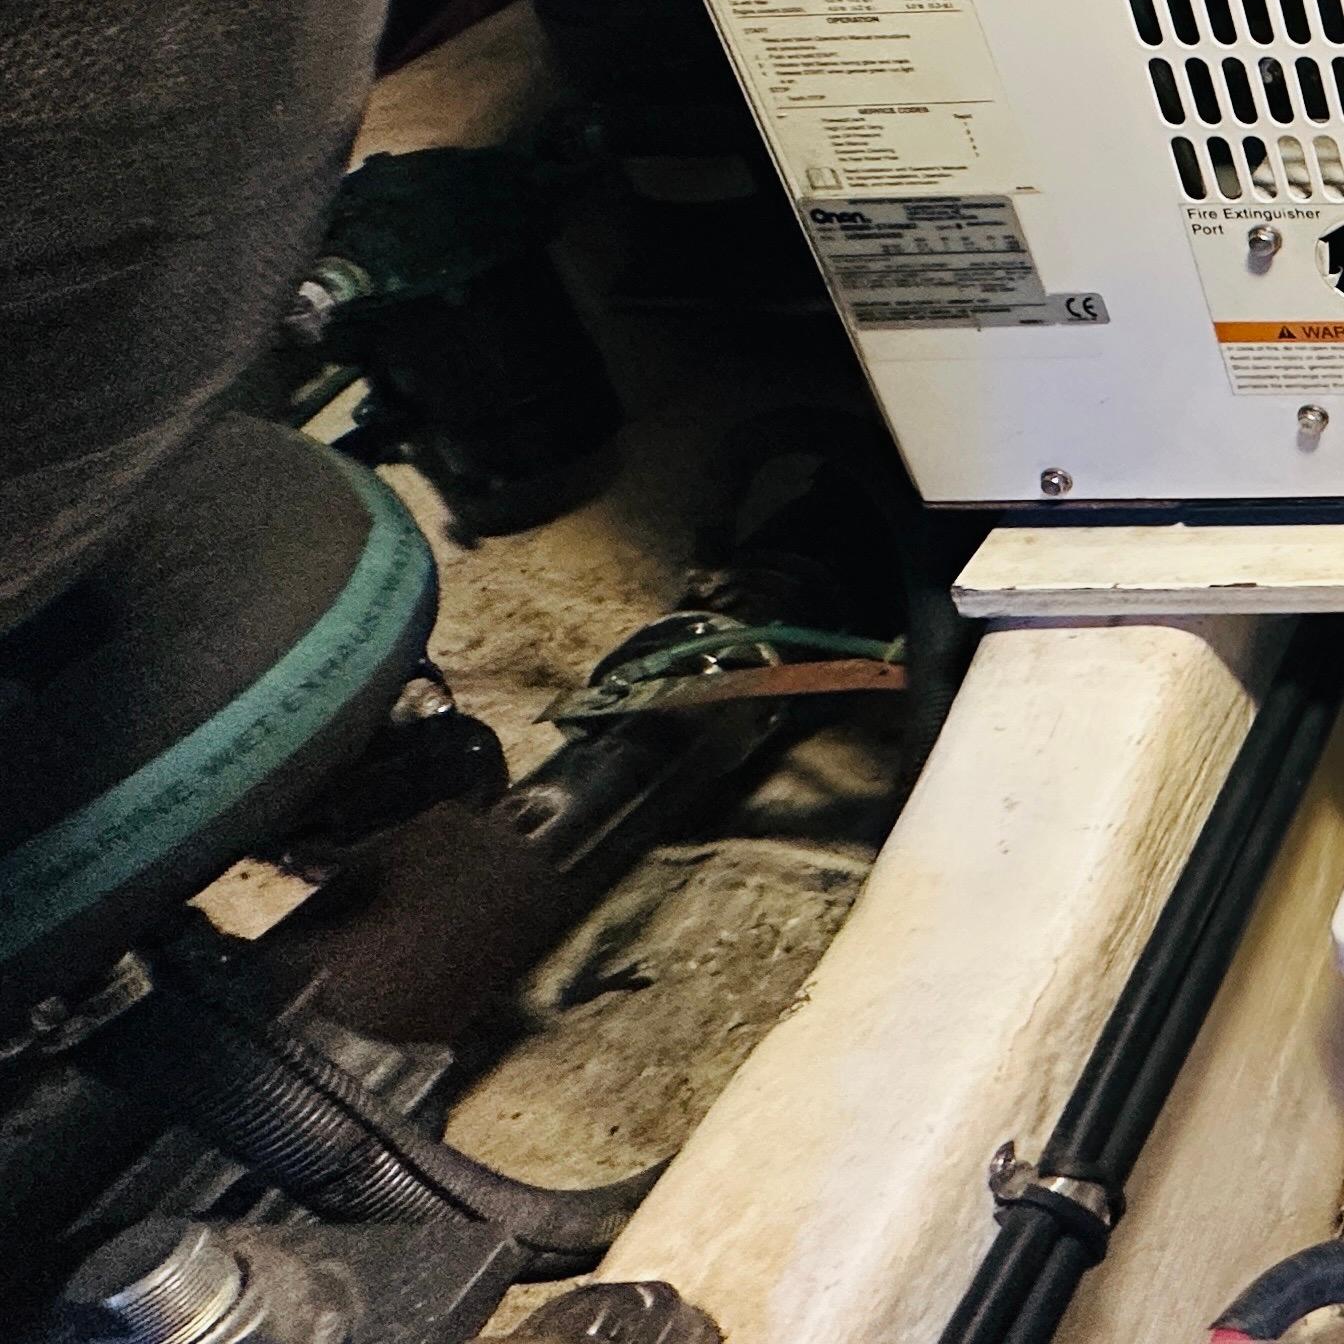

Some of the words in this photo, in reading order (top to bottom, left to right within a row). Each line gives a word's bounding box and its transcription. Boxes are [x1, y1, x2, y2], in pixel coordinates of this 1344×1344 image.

[1187, 208, 1218, 220] Fire
[1223, 209, 1321, 222] Extinguisher
[1192, 224, 1224, 235] Port
